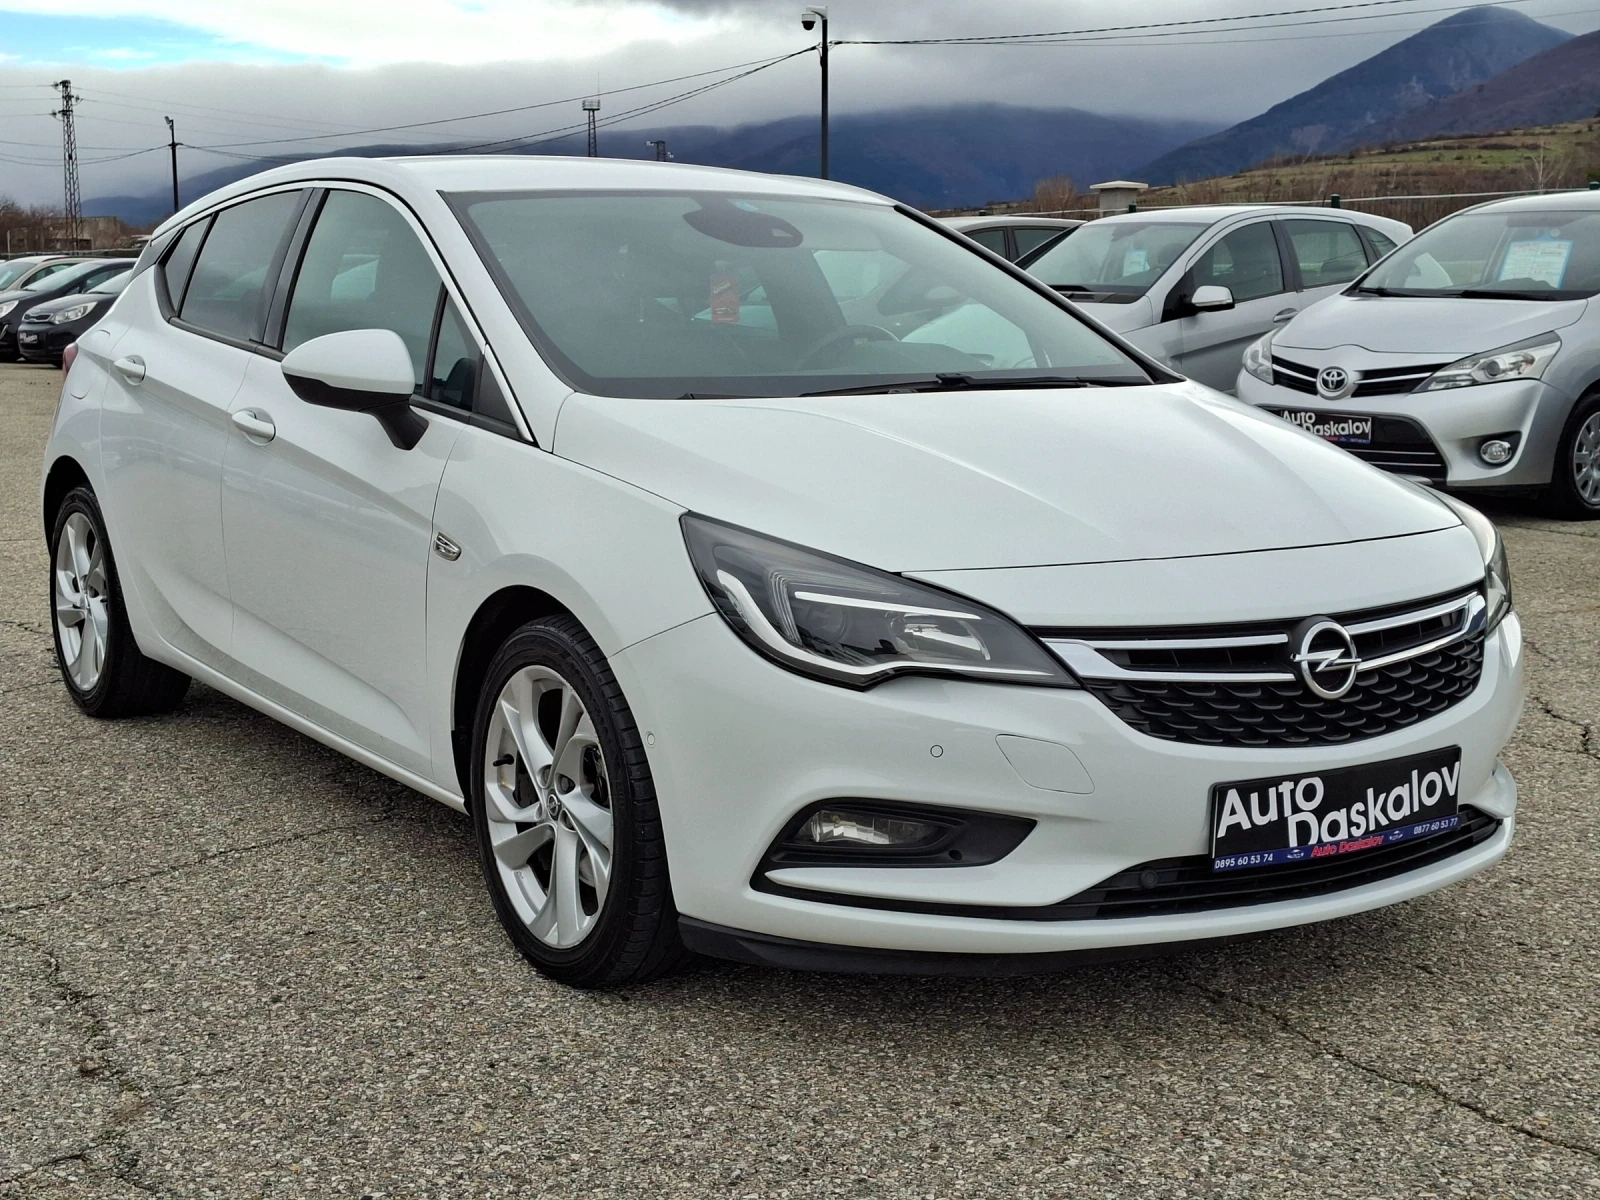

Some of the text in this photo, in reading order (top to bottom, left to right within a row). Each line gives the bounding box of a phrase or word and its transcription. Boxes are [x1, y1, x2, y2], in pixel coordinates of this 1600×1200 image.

[1282, 410, 1316, 424] Auto
[1302, 419, 1370, 436] Daskalov
[1217, 776, 1325, 839] Auto
[1287, 761, 1461, 848] Daskalov
[1413, 817, 1458, 835] 0877 60 53 77
[1311, 835, 1385, 857] Auto Daskalov
[1214, 853, 1274, 869] 0895 60 53 74
